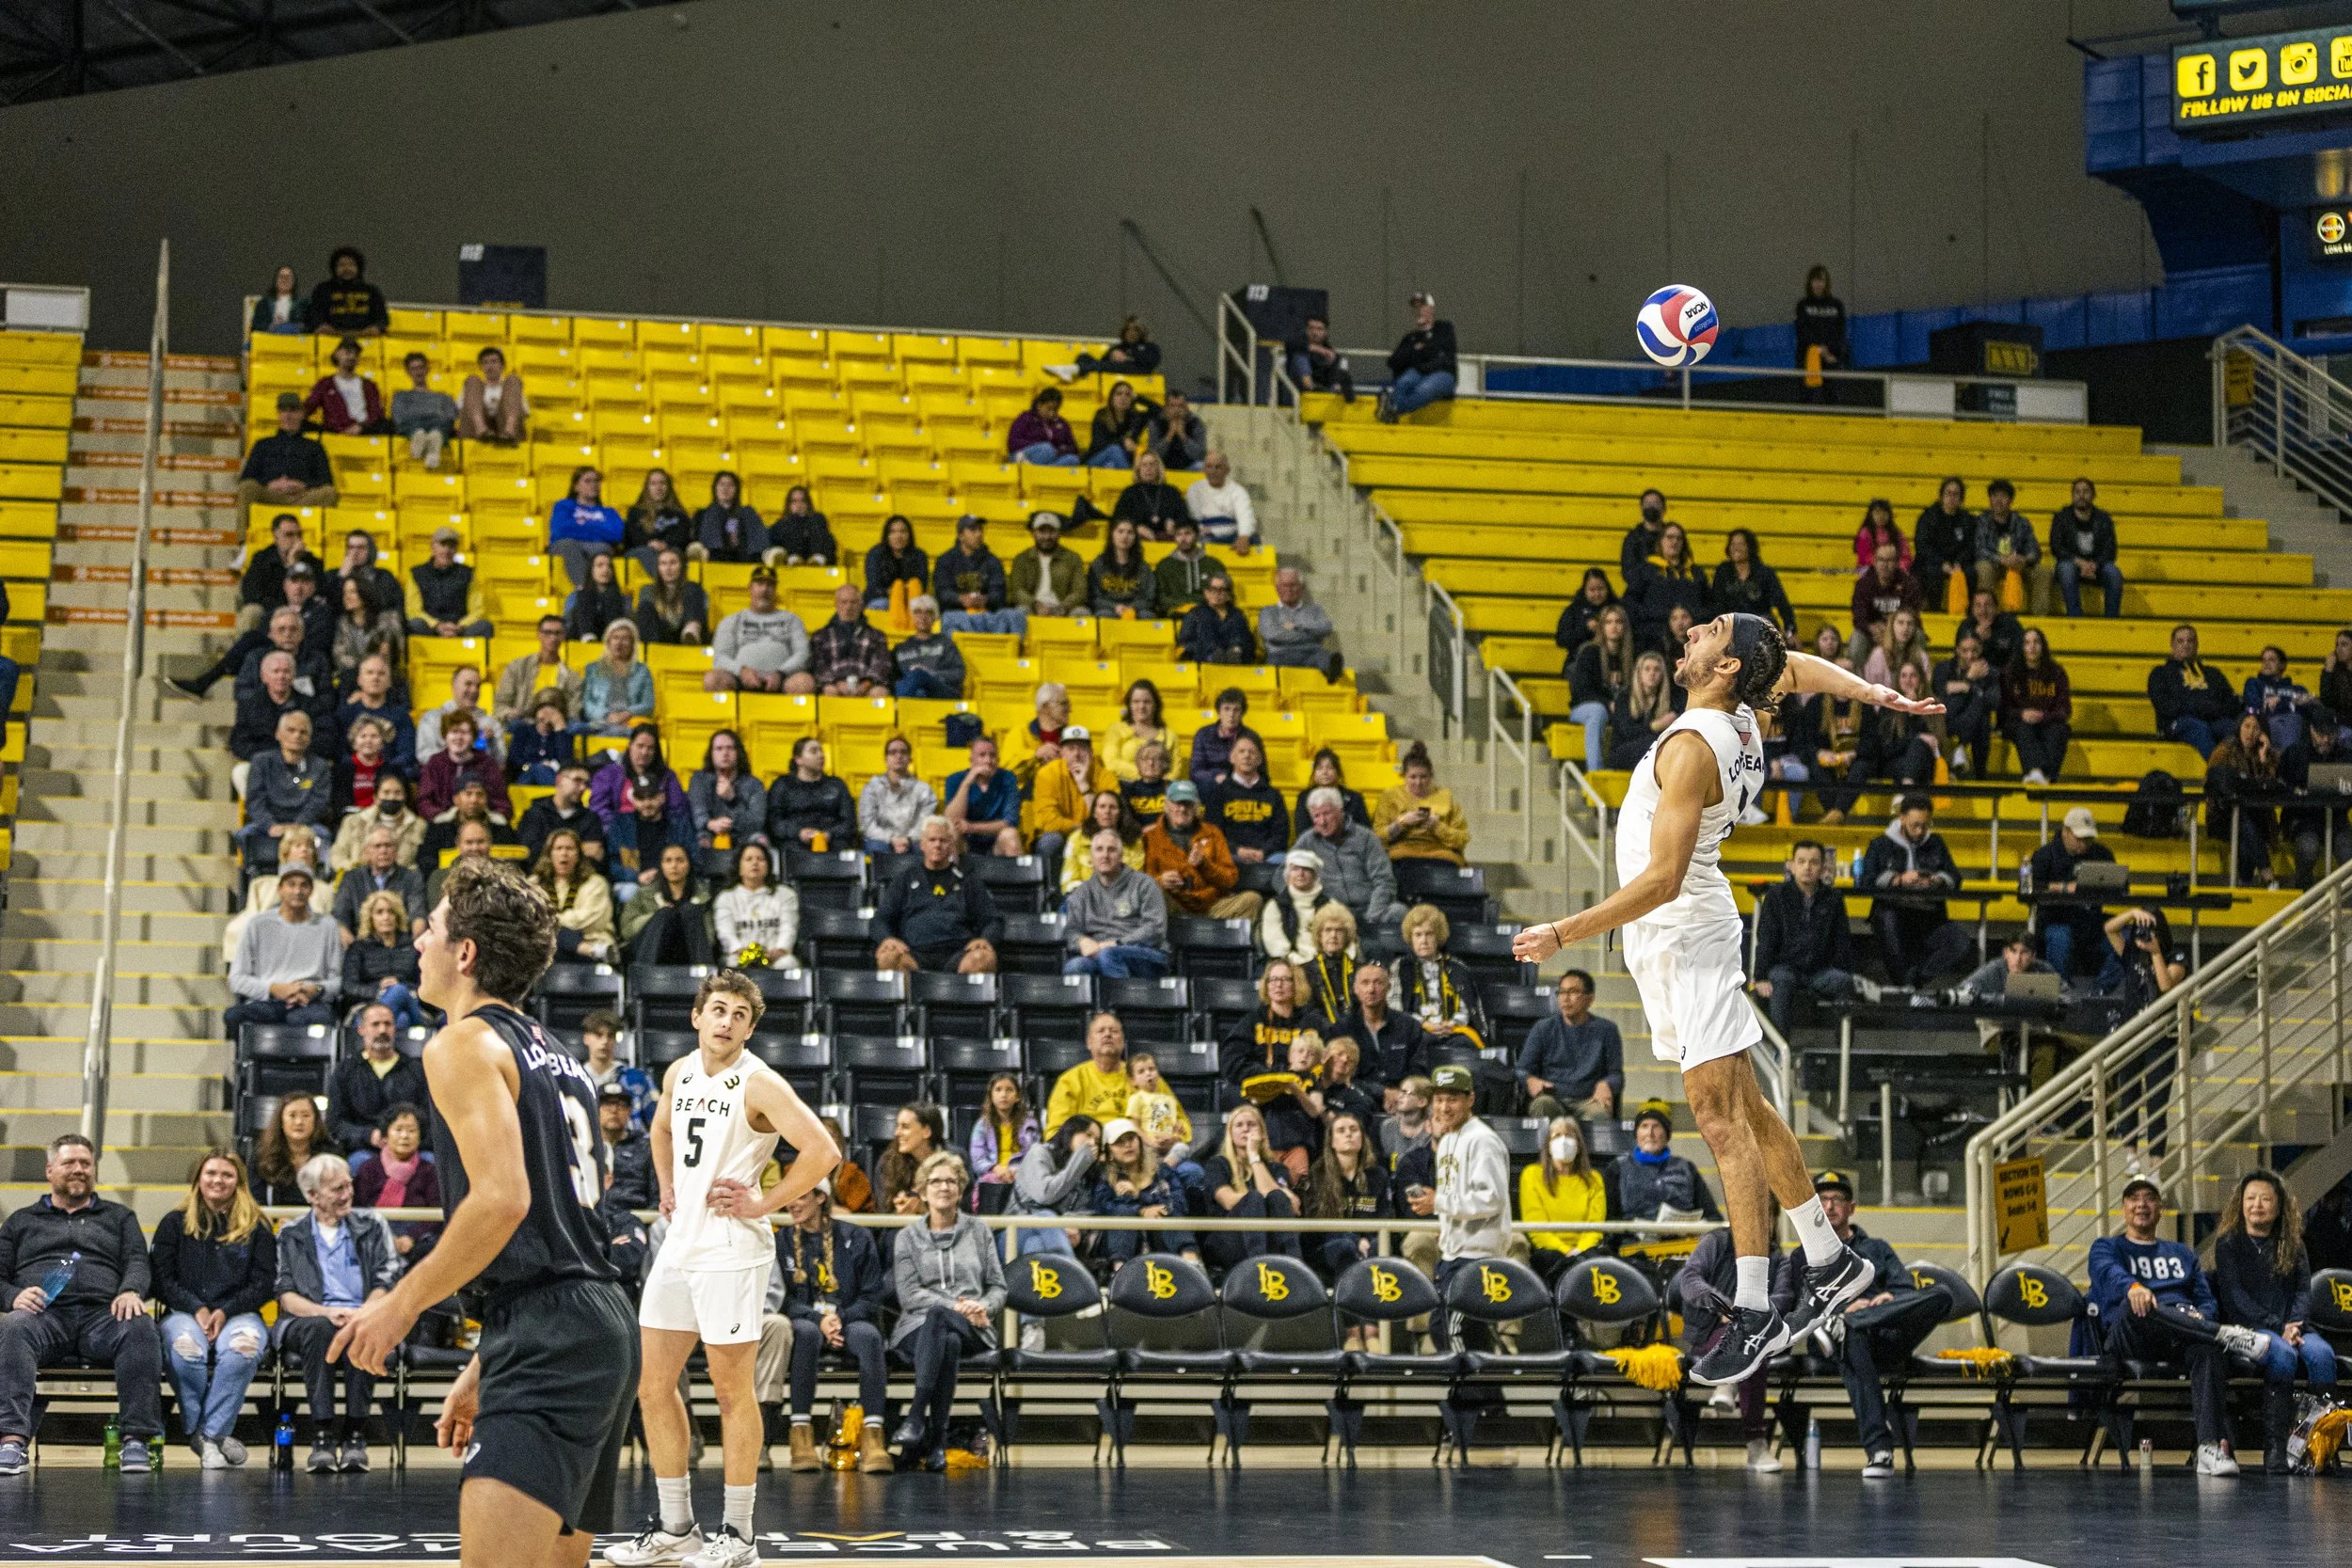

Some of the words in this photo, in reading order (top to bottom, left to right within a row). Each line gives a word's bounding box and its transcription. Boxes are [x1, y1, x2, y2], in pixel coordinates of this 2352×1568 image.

[2180, 95, 2249, 119] FOLLOW
[2250, 92, 2273, 110] US
[2276, 89, 2300, 107] ON
[2302, 83, 2352, 105] SOCIA
[1685, 300, 1708, 319] NCAA
[675, 1098, 730, 1117] BEACH
[684, 1117, 706, 1168] 5
[1029, 1260, 1062, 1299] LB
[1145, 1260, 1177, 1300] LB
[1257, 1262, 1290, 1302] LB
[1370, 1264, 1403, 1304] LB
[1480, 1265, 1513, 1305] LB
[1590, 1266, 1622, 1306] LB
[2129, 1256, 2185, 1280] 1983
[2016, 1272, 2049, 1308] LB
[62, 1532, 461, 1544] COURT
[771, 1539, 1173, 1552] BRUCE
